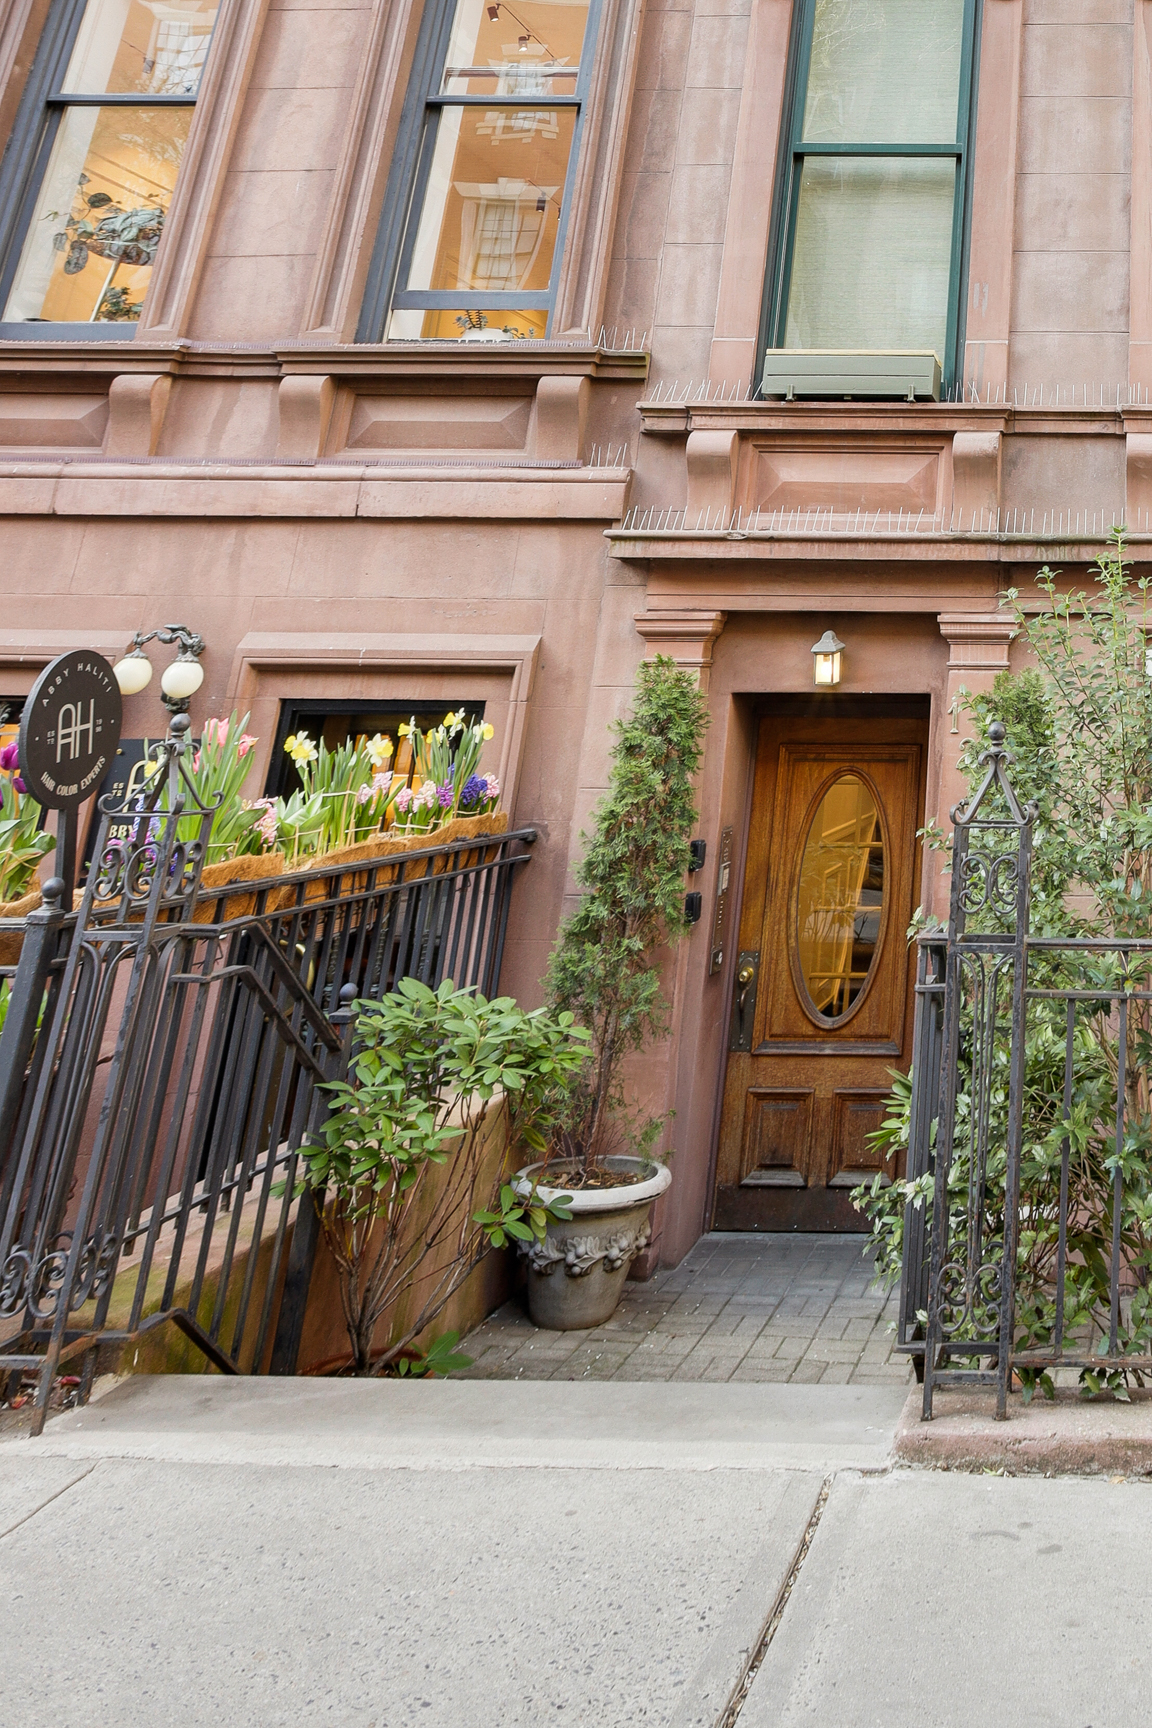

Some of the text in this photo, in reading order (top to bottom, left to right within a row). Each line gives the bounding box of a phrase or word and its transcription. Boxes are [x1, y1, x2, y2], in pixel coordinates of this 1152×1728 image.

[42, 662, 112, 708] ABBY HALITI
[40, 755, 106, 796] HAIR COLOR EXPERTS
[112, 782, 125, 790] ES
